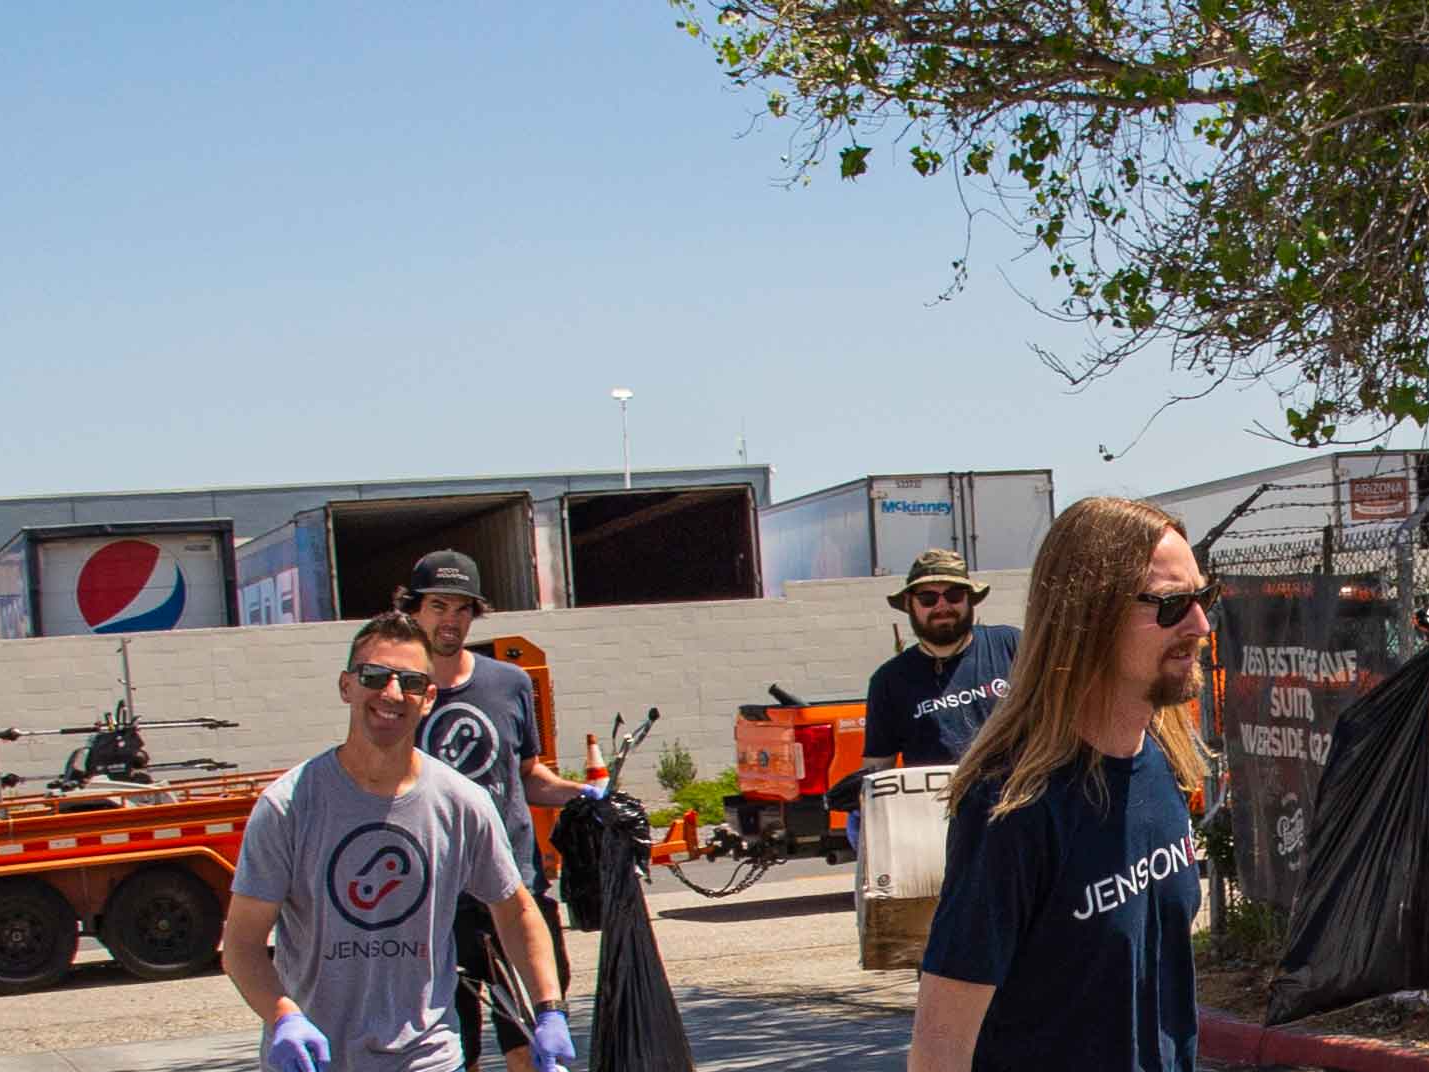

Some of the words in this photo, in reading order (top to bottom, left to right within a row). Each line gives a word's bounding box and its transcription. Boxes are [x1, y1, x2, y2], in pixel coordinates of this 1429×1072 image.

[913, 685, 987, 719] JENSON
[1073, 837, 1189, 920] JENSON
[323, 940, 418, 961] JENSON
